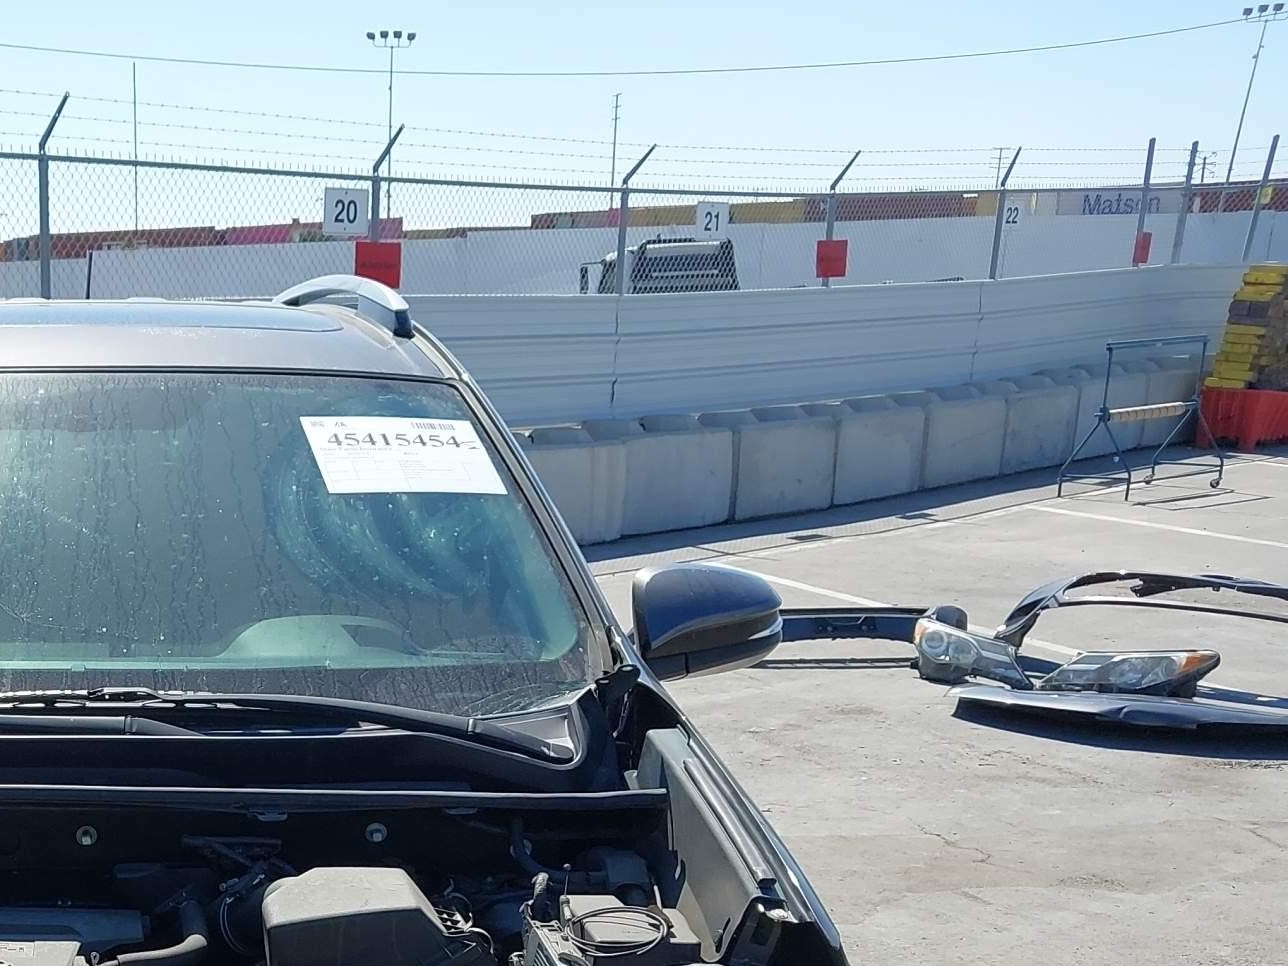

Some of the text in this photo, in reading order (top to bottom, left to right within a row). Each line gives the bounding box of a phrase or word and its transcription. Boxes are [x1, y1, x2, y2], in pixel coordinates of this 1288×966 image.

[333, 198, 358, 224] 20
[703, 210, 720, 232] 21
[1004, 206, 1020, 224] 22
